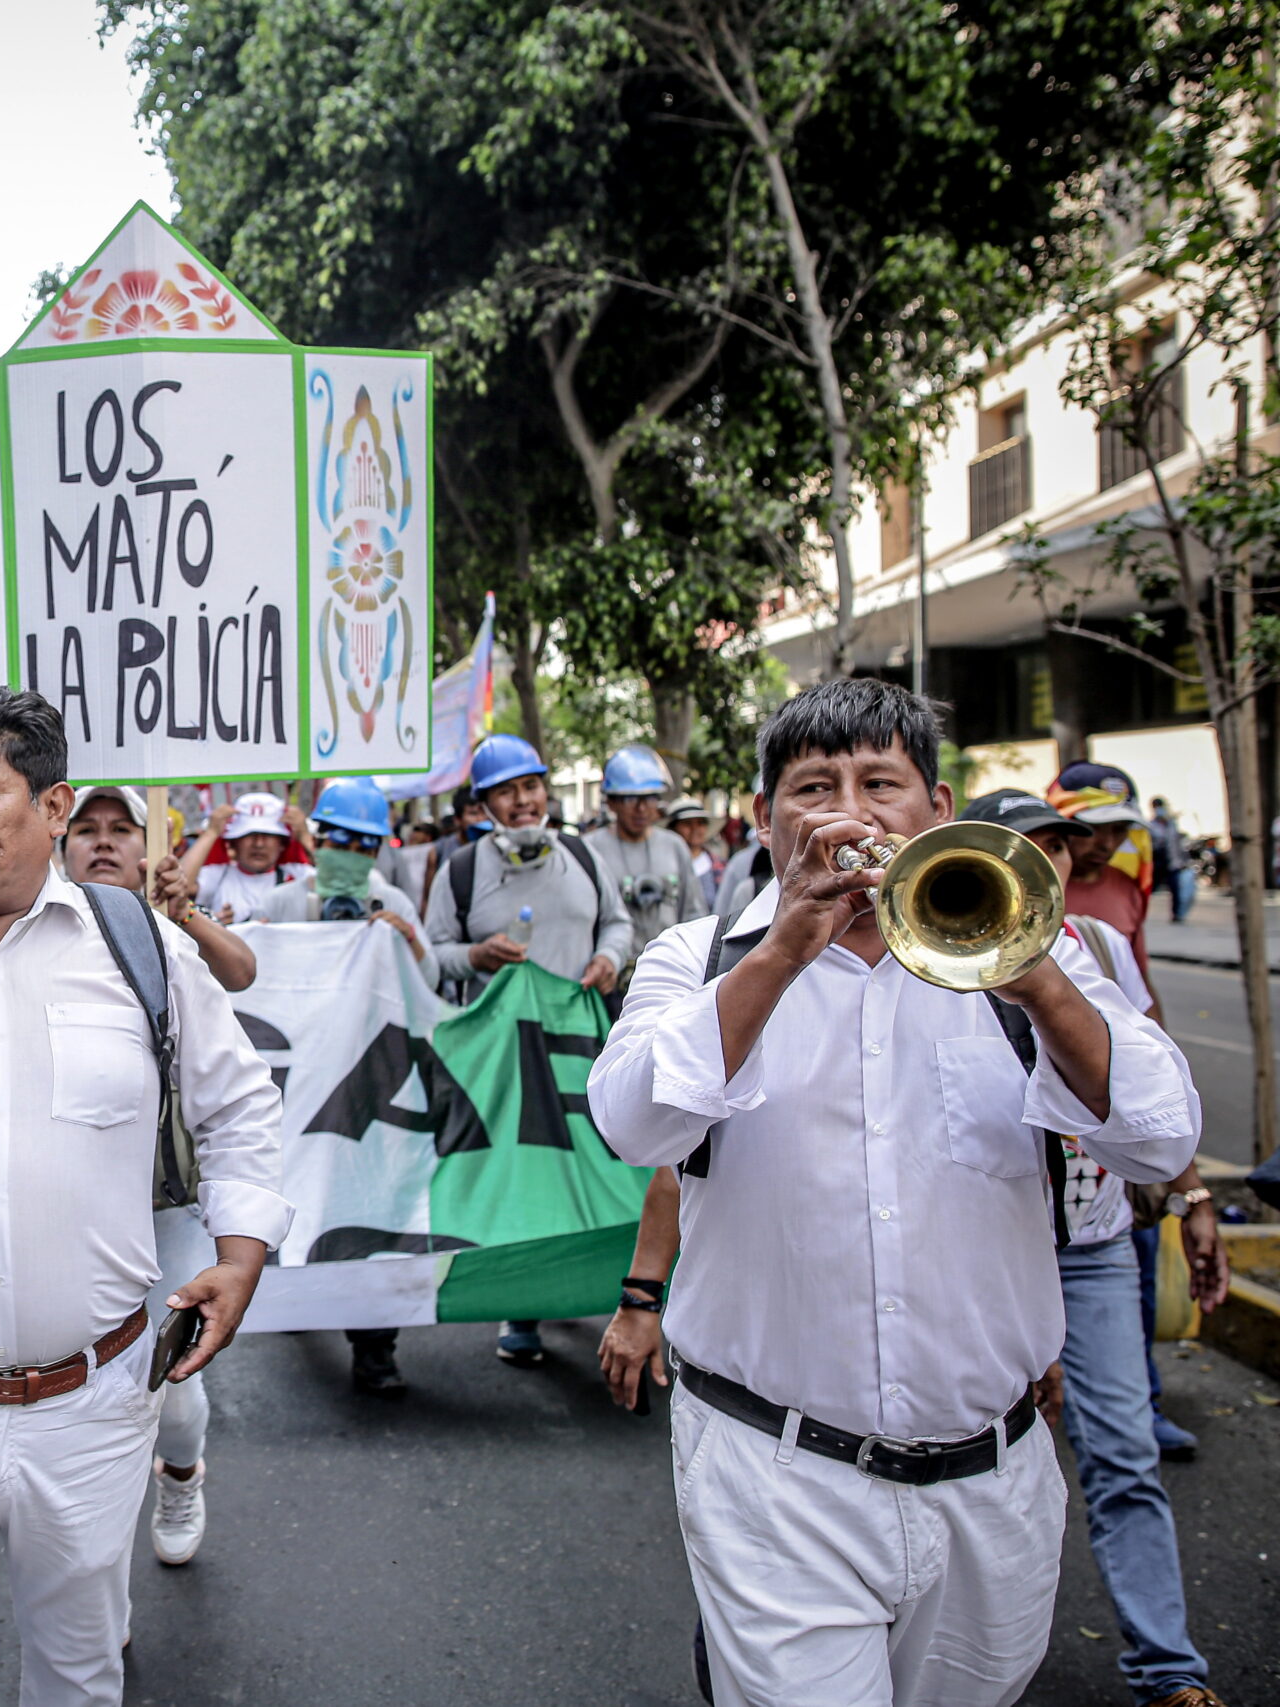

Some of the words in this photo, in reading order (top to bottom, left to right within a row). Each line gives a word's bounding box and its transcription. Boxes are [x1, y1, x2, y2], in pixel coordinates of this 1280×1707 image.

[57, 380, 182, 486] LOS
[43, 454, 234, 619] MATÓ
[26, 626, 92, 743] LA
